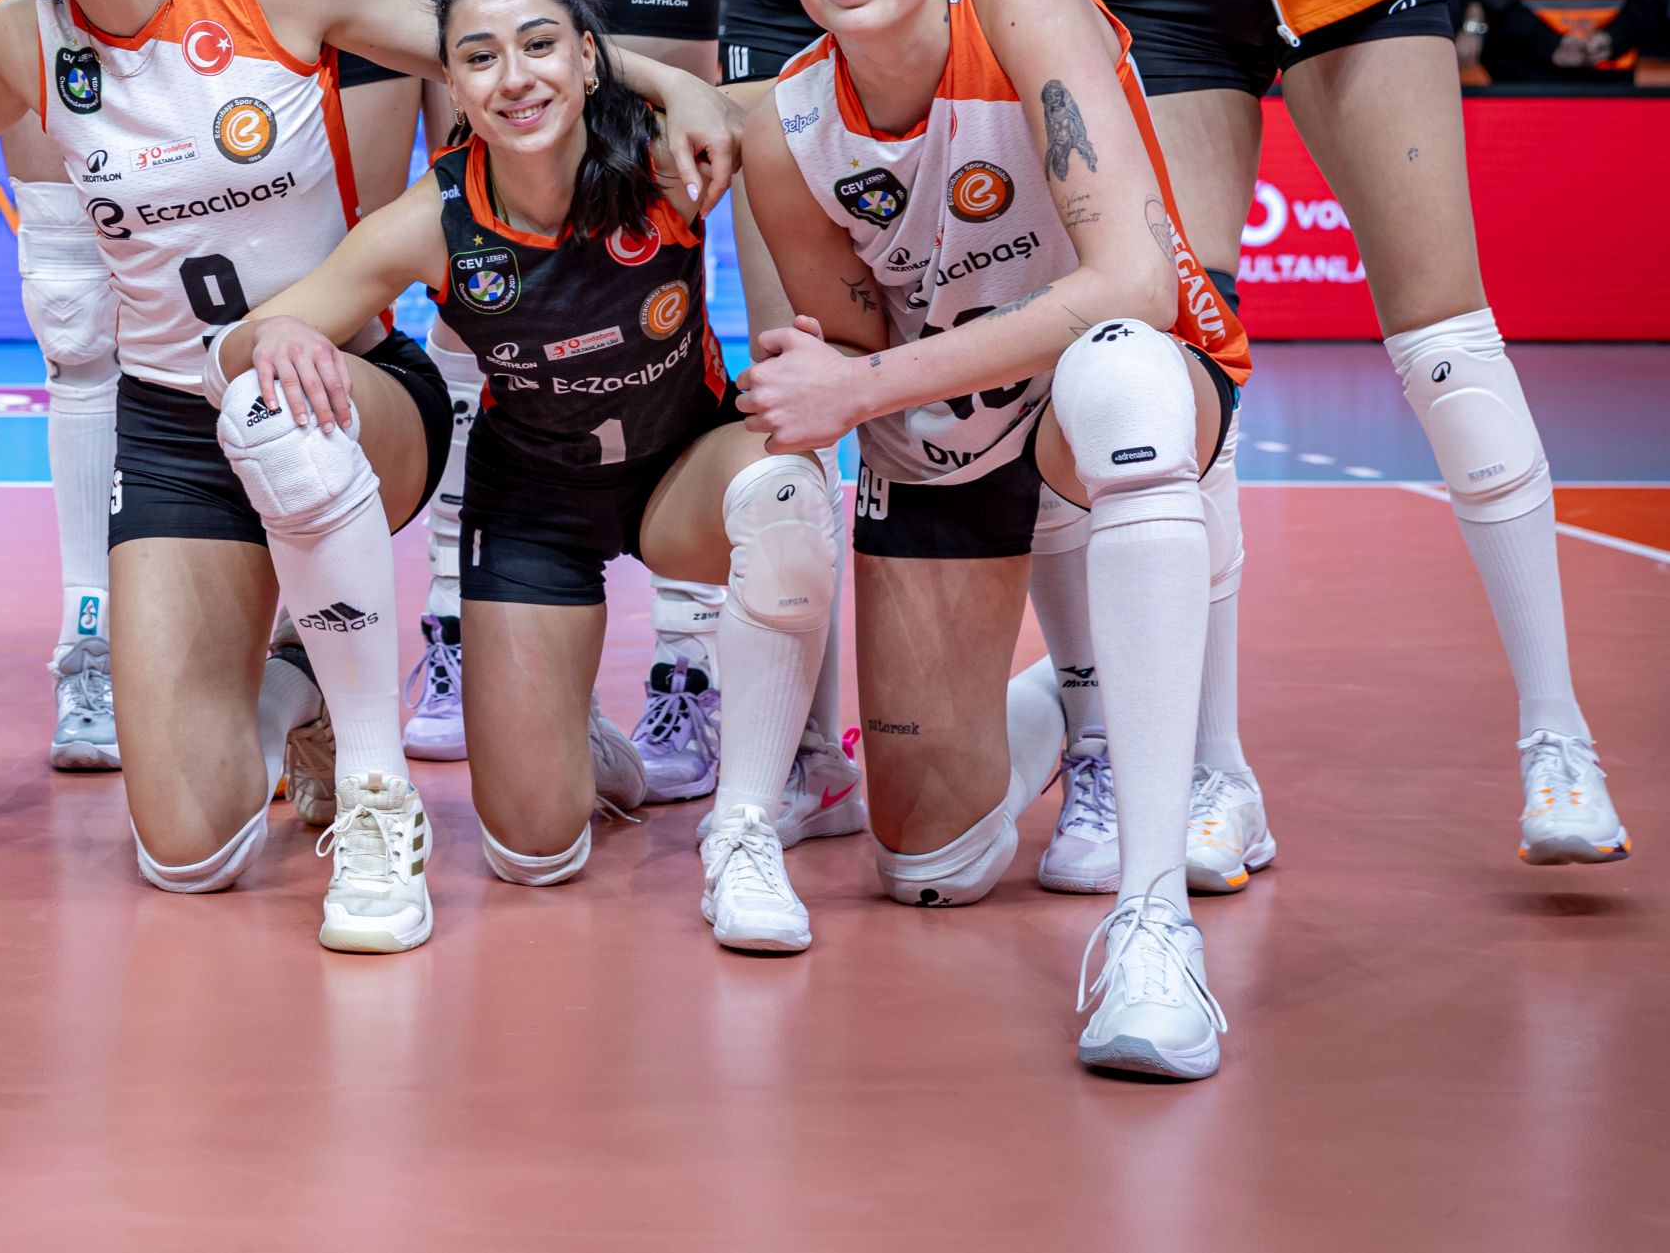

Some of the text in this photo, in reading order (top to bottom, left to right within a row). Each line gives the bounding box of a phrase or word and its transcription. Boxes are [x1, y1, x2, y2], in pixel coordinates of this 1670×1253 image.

[781, 107, 819, 135] Selpak
[162, 142, 193, 154] vodafone
[152, 155, 183, 166] SULTANLAR
[83, 172, 122, 183] DECATHLON
[440, 185, 461, 202] pak
[840, 181, 864, 196] CEV
[136, 171, 297, 226] Eczacıbaşı
[457, 258, 483, 270] CEV
[486, 355, 538, 370] DECATHLON
[553, 331, 692, 394] Eczacıbaşı
[246, 406, 283, 427] adidas
[589, 418, 627, 466] 1
[1467, 462, 1507, 483] KIPSTA
[298, 611, 379, 633] adidas
